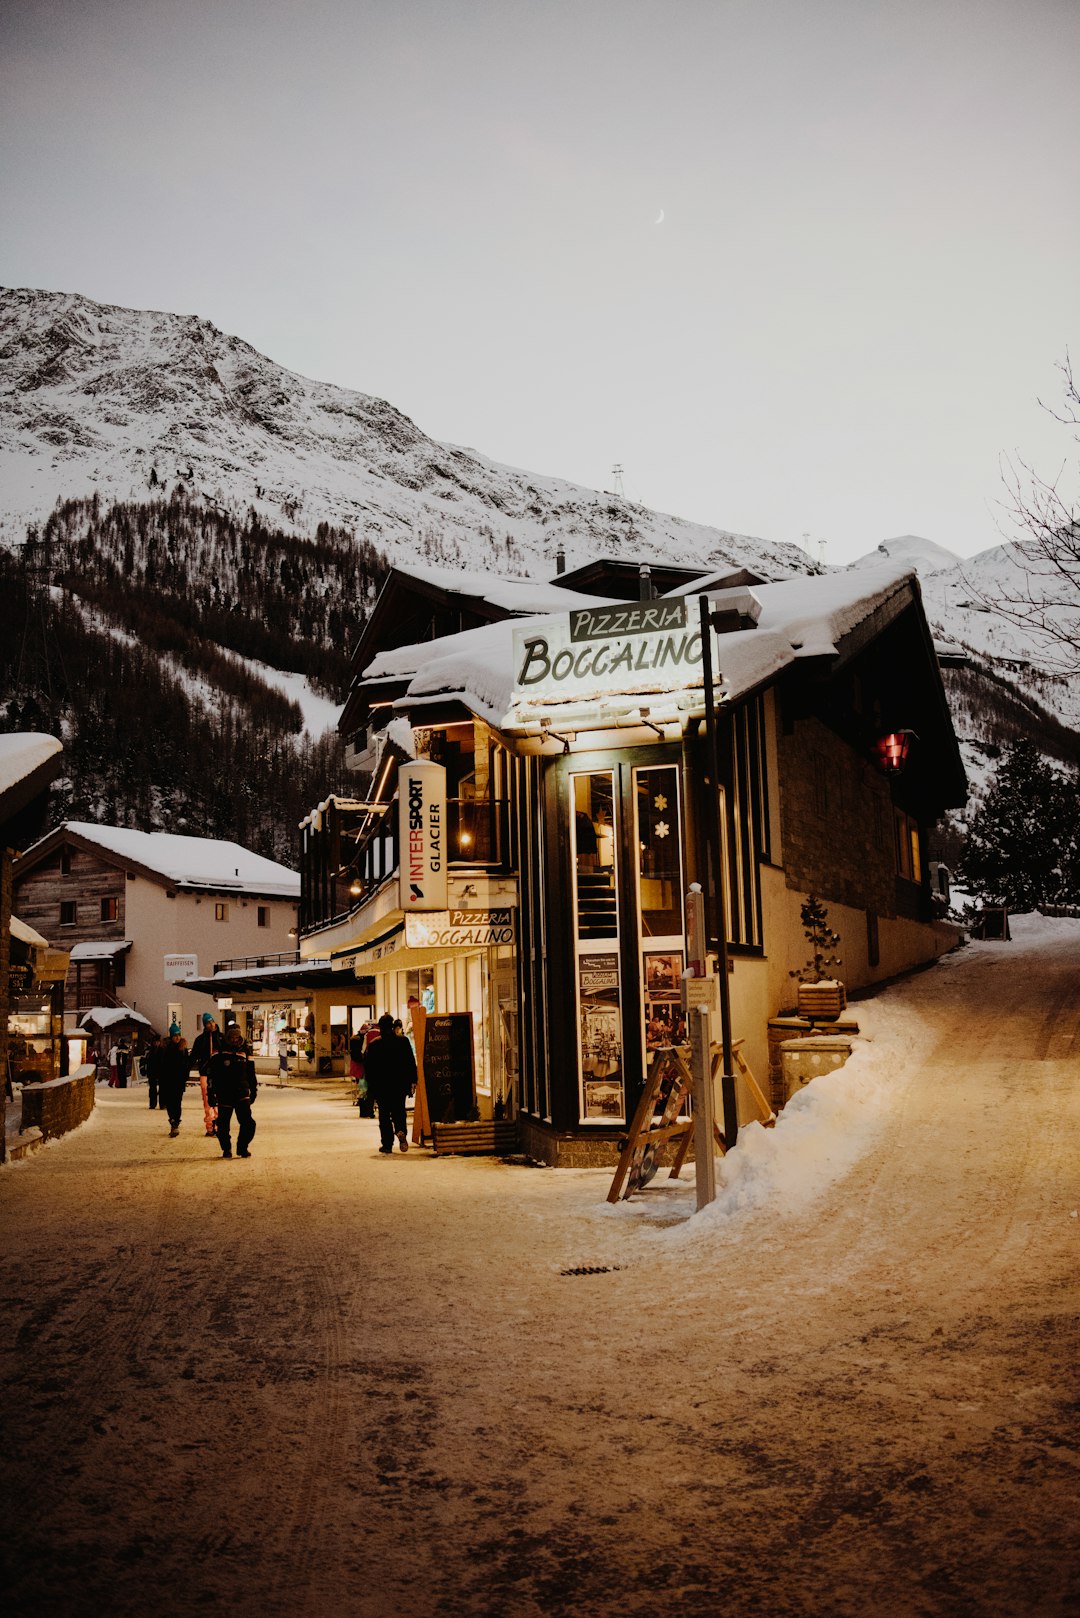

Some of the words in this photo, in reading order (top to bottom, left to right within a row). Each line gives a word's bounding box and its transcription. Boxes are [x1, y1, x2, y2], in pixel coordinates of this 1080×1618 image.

[573, 604, 682, 637] PIZZERIA
[517, 631, 704, 686] BOCCALINO
[408, 778, 424, 881] INTERSPORT
[429, 803, 441, 873] GLACIER
[414, 928, 513, 946] OCCALINO
[452, 910, 510, 925] PIZZERIA
